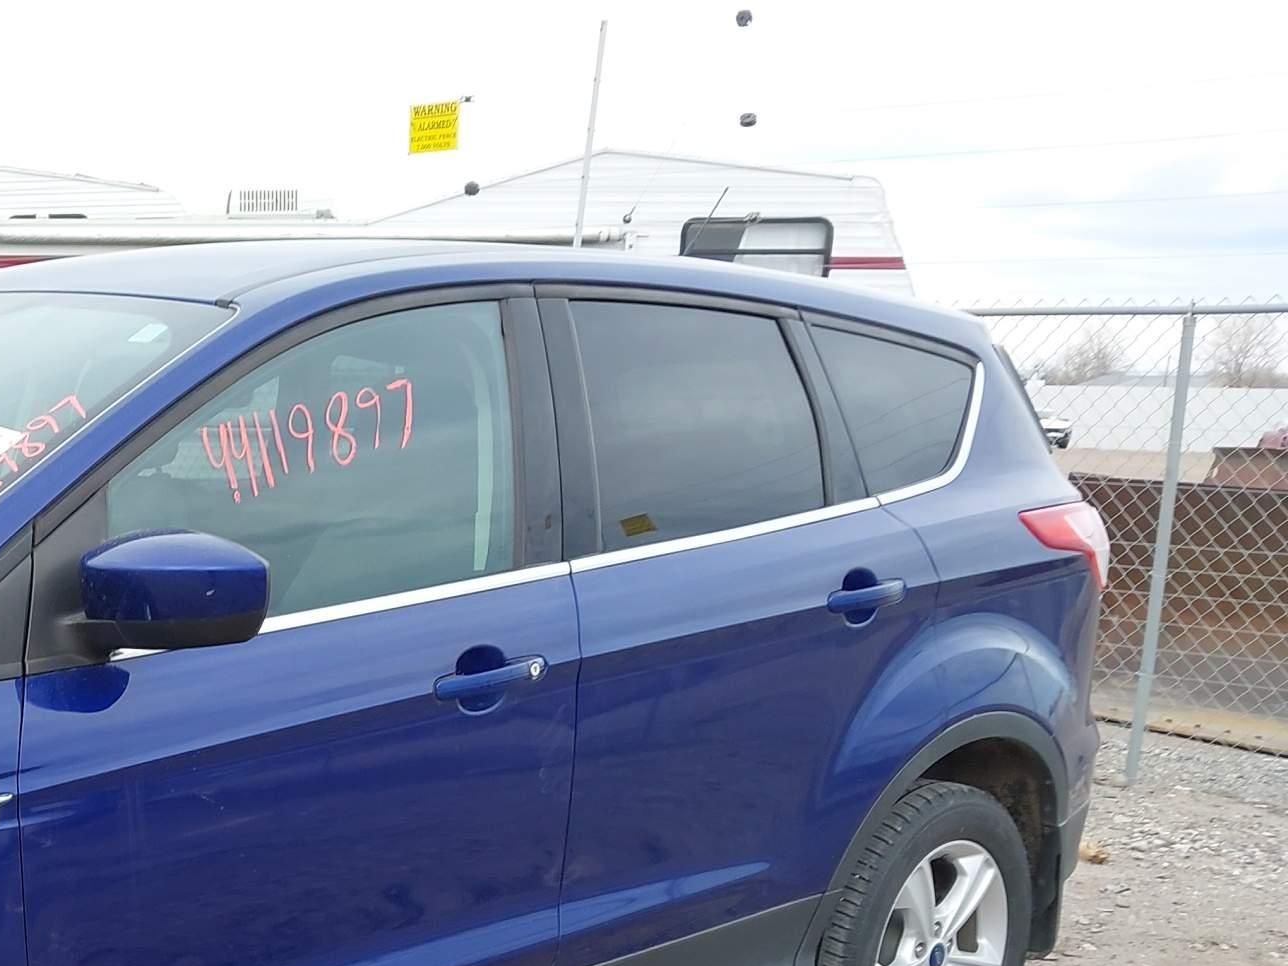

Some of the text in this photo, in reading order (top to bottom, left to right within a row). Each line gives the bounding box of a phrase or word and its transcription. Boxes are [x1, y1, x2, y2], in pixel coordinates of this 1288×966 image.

[413, 102, 457, 117] WARNING
[417, 119, 452, 131] ALARMED
[201, 378, 412, 504] 44119897
